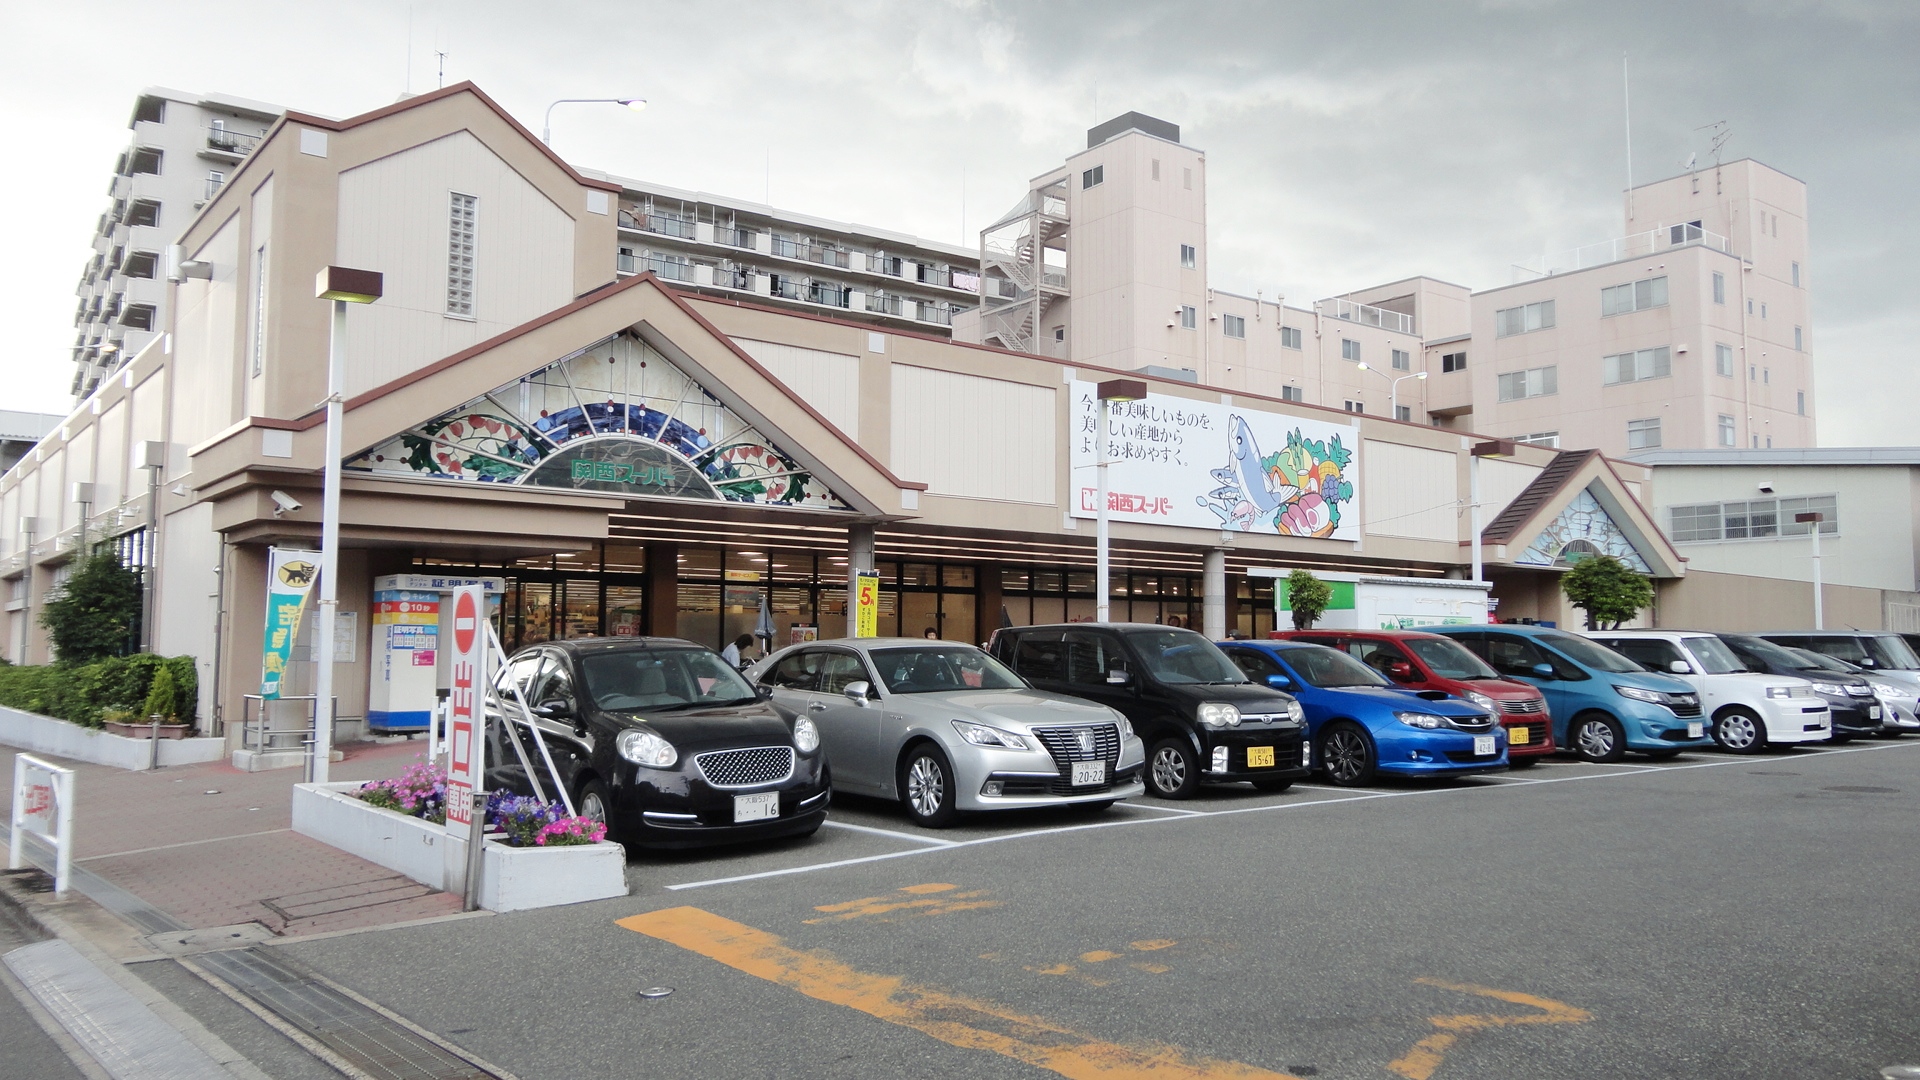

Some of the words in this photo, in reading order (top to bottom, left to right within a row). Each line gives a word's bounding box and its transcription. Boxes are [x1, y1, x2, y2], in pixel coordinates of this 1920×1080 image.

[1081, 393, 1214, 431] 今、番美味しいものを、
[571, 459, 676, 487] 関西スーパー
[452, 660, 473, 777] 出口
[1254, 755, 1273, 765] 15-67
[1079, 770, 1103, 783] 20-22
